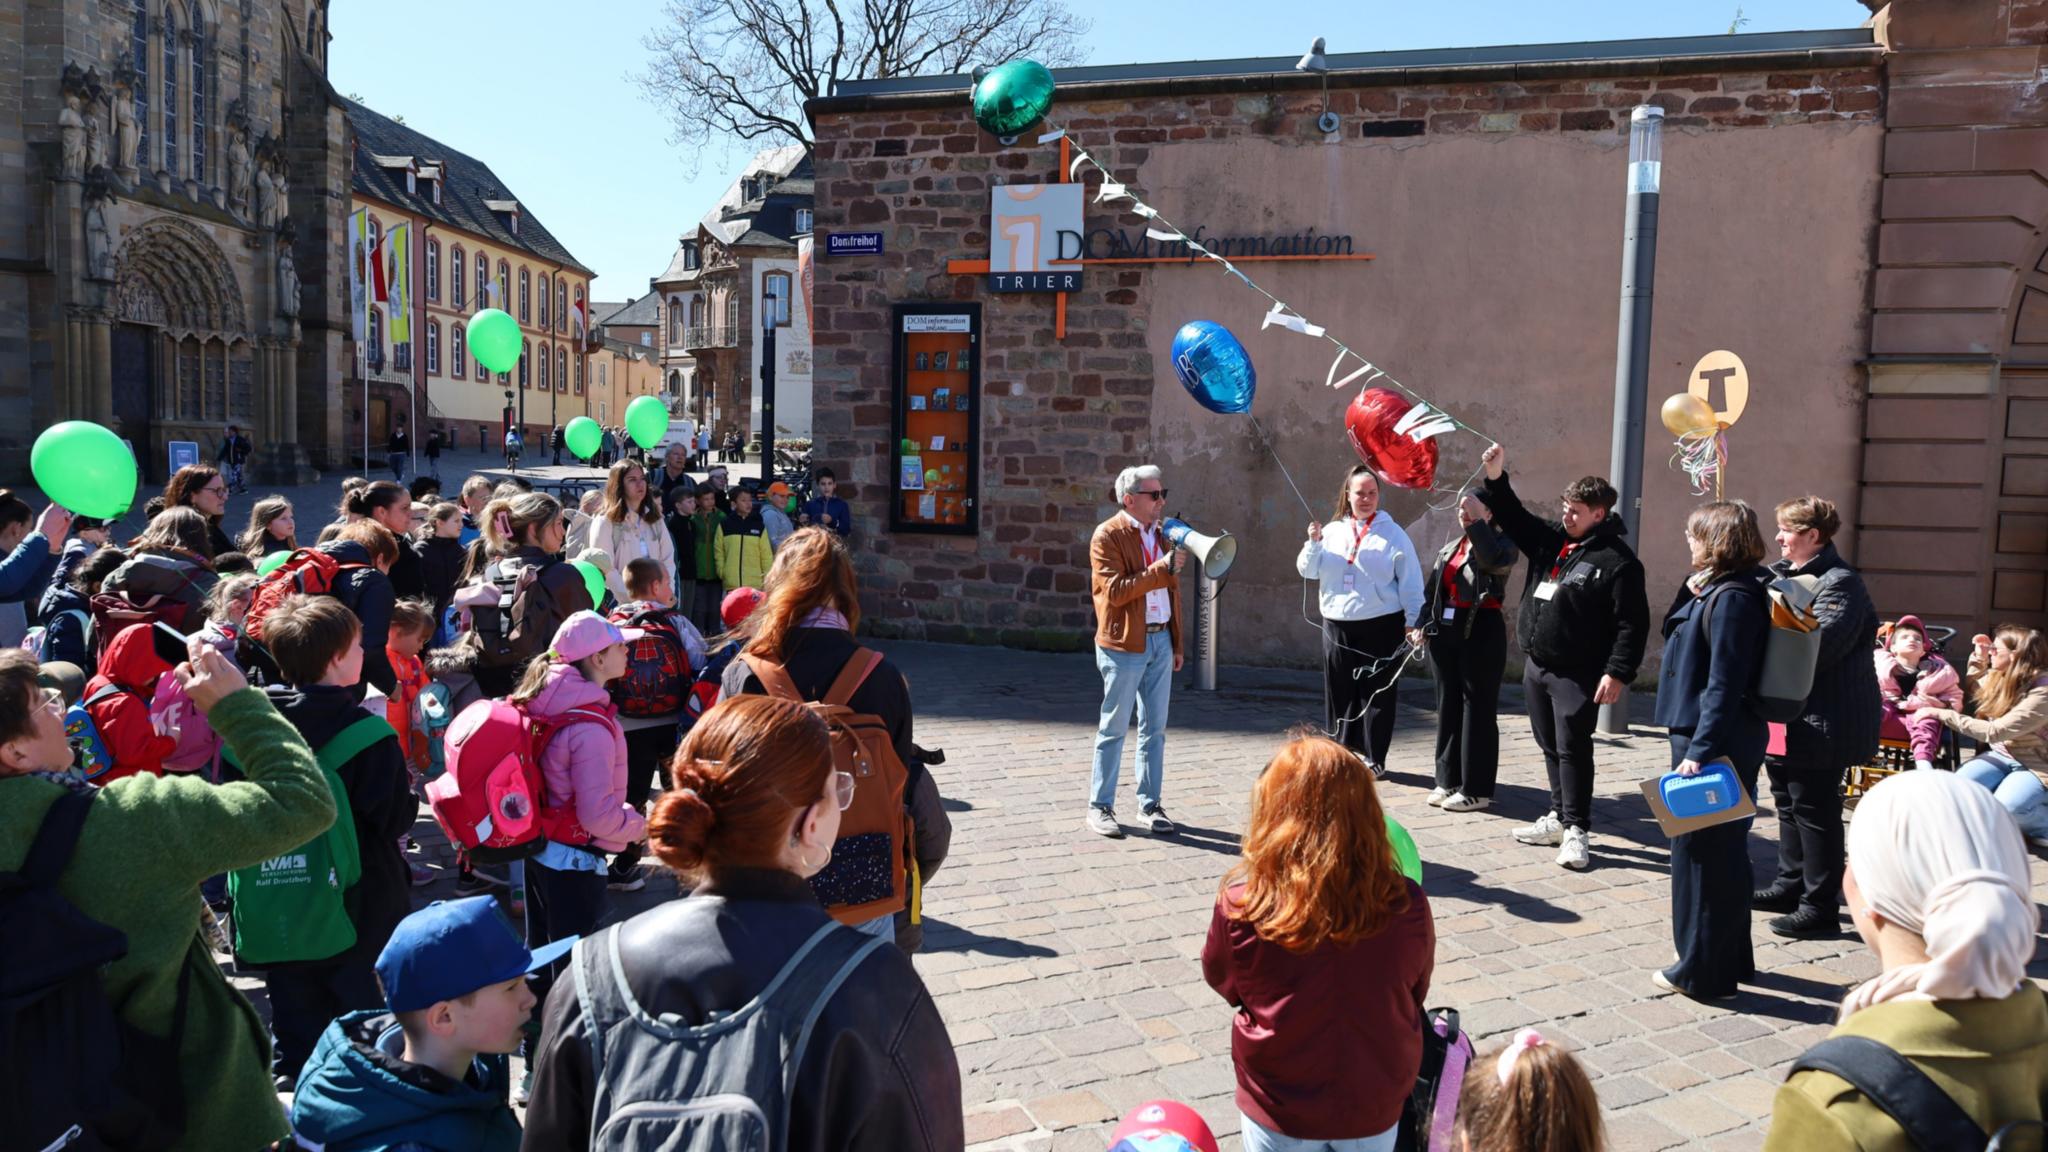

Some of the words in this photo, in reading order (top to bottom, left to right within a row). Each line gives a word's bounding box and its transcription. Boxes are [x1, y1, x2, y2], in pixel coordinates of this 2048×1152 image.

[832, 235, 877, 247] Domfreihof
[997, 275, 1073, 289] TRIER
[1699, 367, 1736, 413] T
[1200, 586, 1209, 660] TRINKWASSER
[261, 856, 293, 872] LVM
